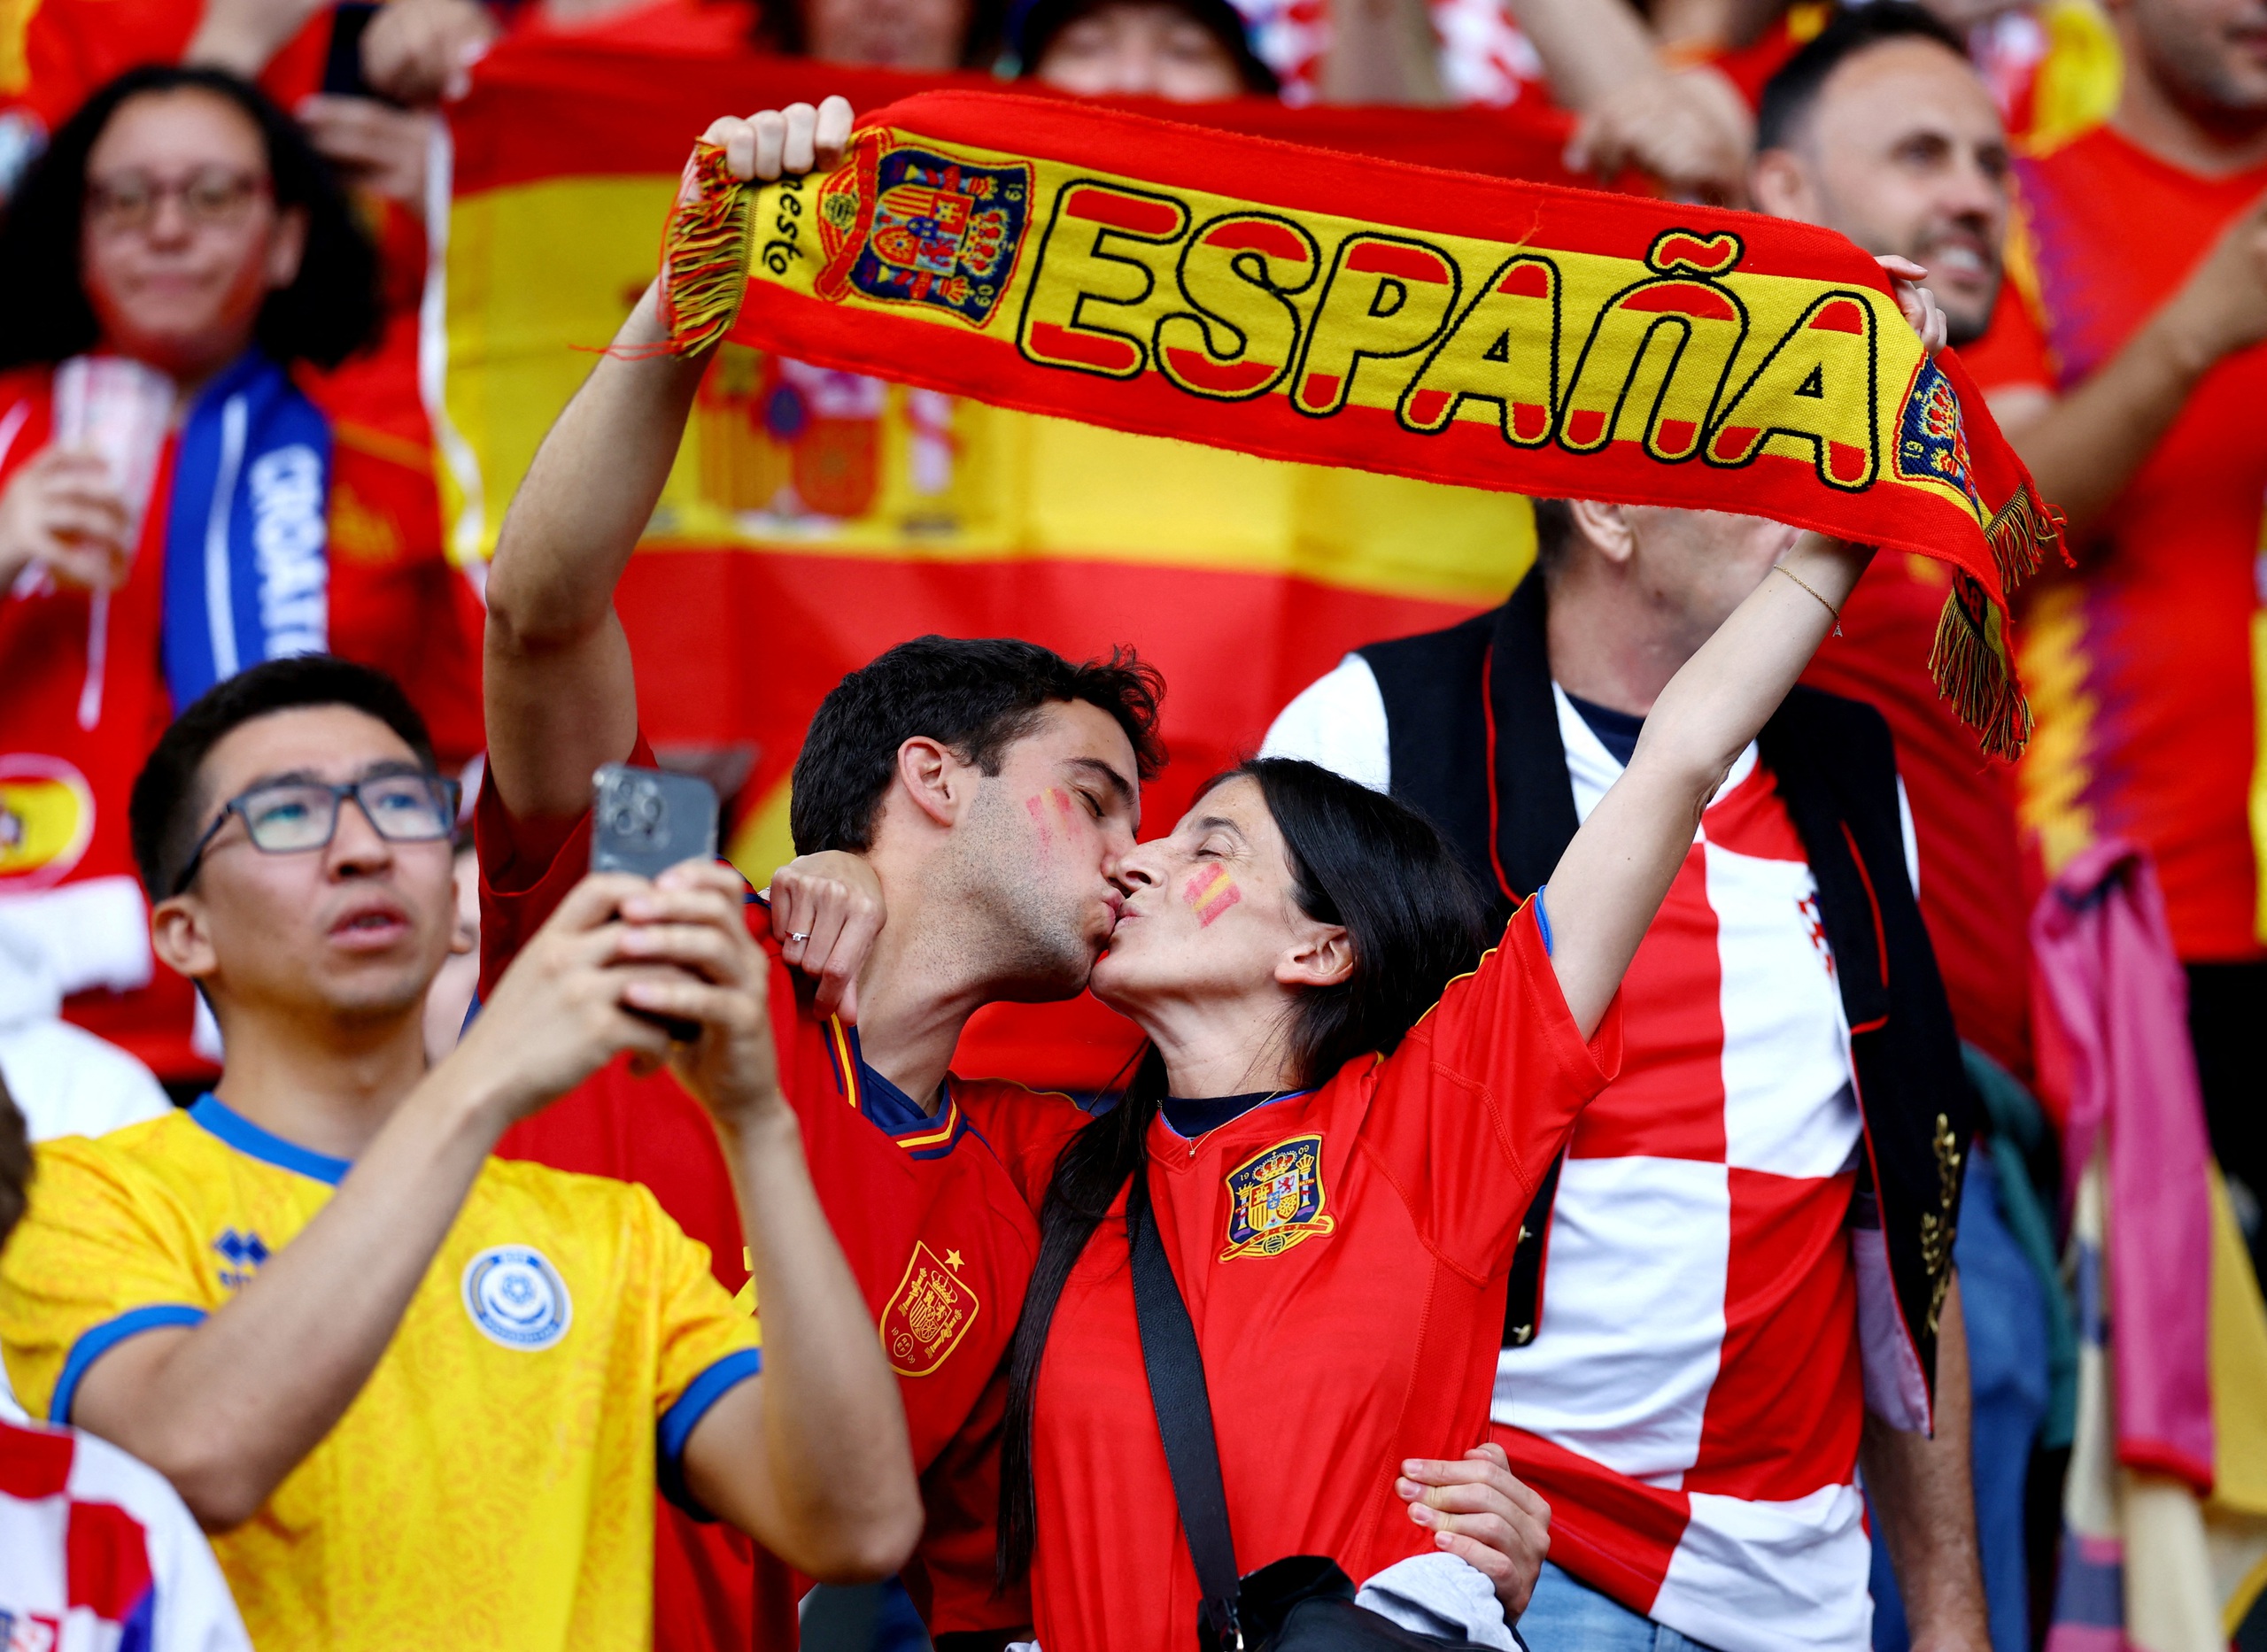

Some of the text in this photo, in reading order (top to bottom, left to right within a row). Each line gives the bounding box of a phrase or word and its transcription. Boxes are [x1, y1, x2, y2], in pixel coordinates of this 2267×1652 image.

[1003, 181, 1024, 202] 19
[973, 283, 994, 307] 09
[1017, 181, 1880, 492] ESPAÑA
[1903, 440, 1924, 459] 19
[1298, 1145, 1309, 1154] 09
[1240, 1172, 1250, 1181] 19
